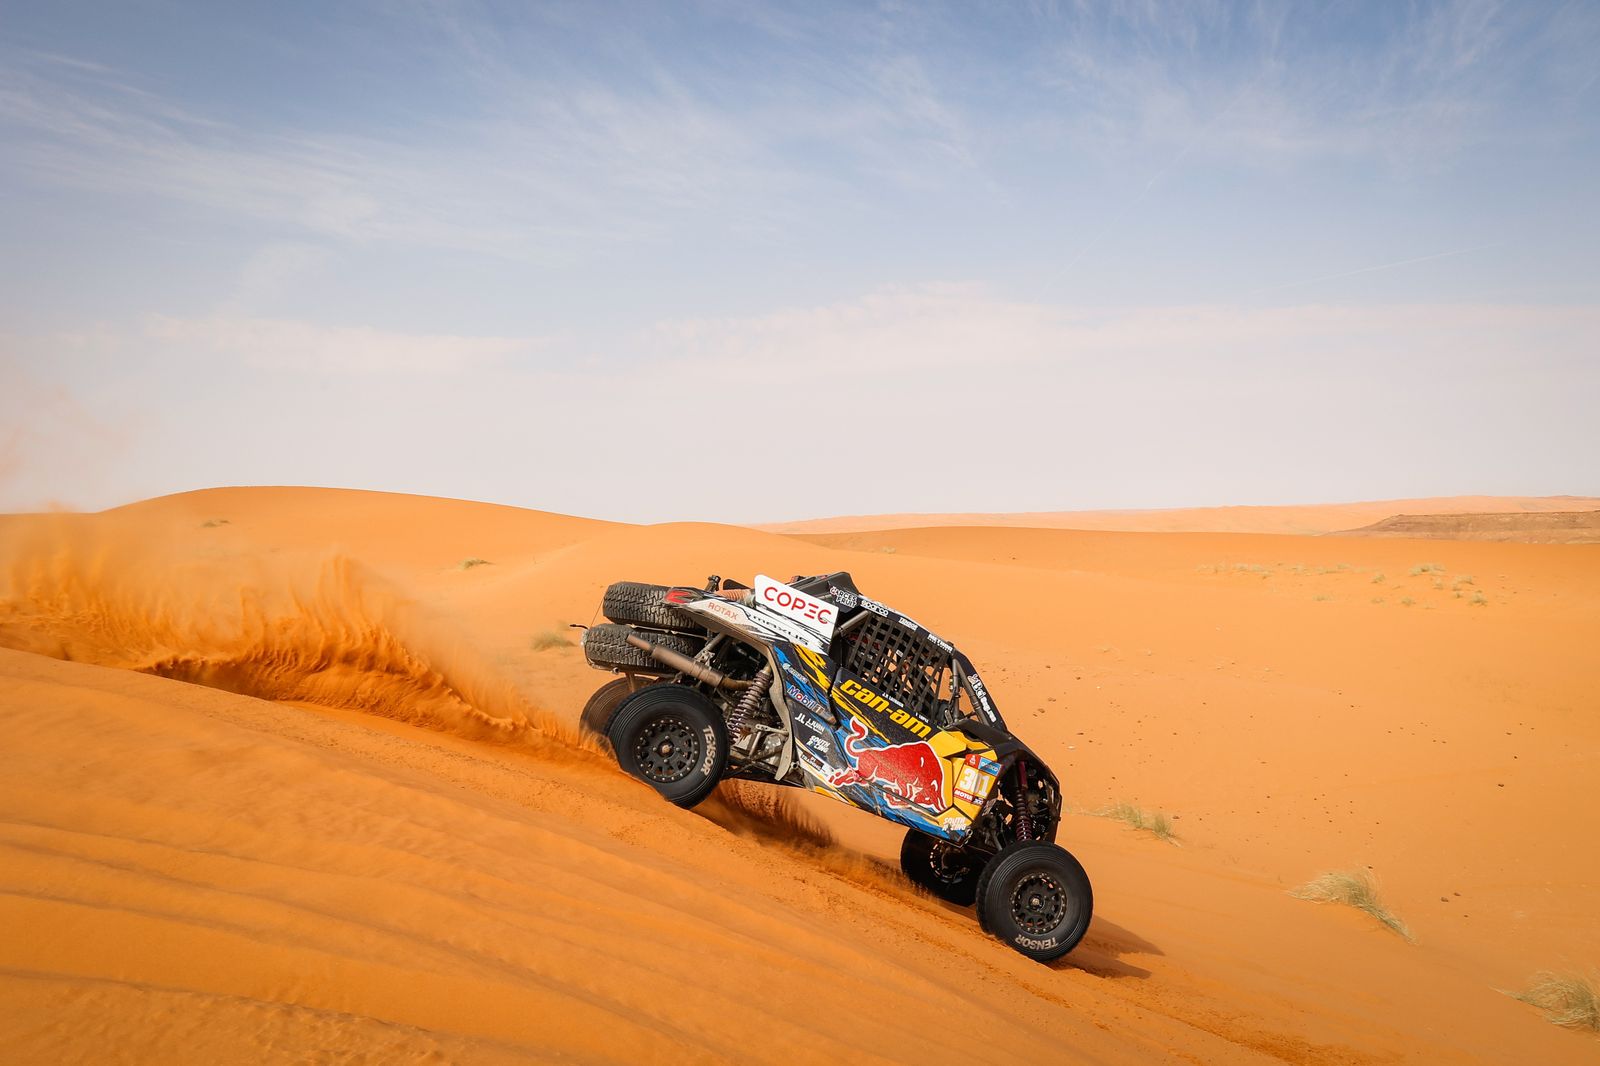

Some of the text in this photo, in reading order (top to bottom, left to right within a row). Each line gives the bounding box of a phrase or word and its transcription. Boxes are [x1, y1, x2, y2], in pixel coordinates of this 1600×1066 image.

[707, 601, 739, 621] ROTAX
[764, 587, 832, 625] COPEC
[787, 685, 816, 709] Mobil
[840, 679, 932, 739] can-am
[701, 724, 716, 775] TENSOR
[811, 735, 830, 748] SOUTH
[954, 790, 973, 801] MOTUL
[944, 817, 966, 826] SOUTH
[1015, 934, 1059, 950] TENSOR
